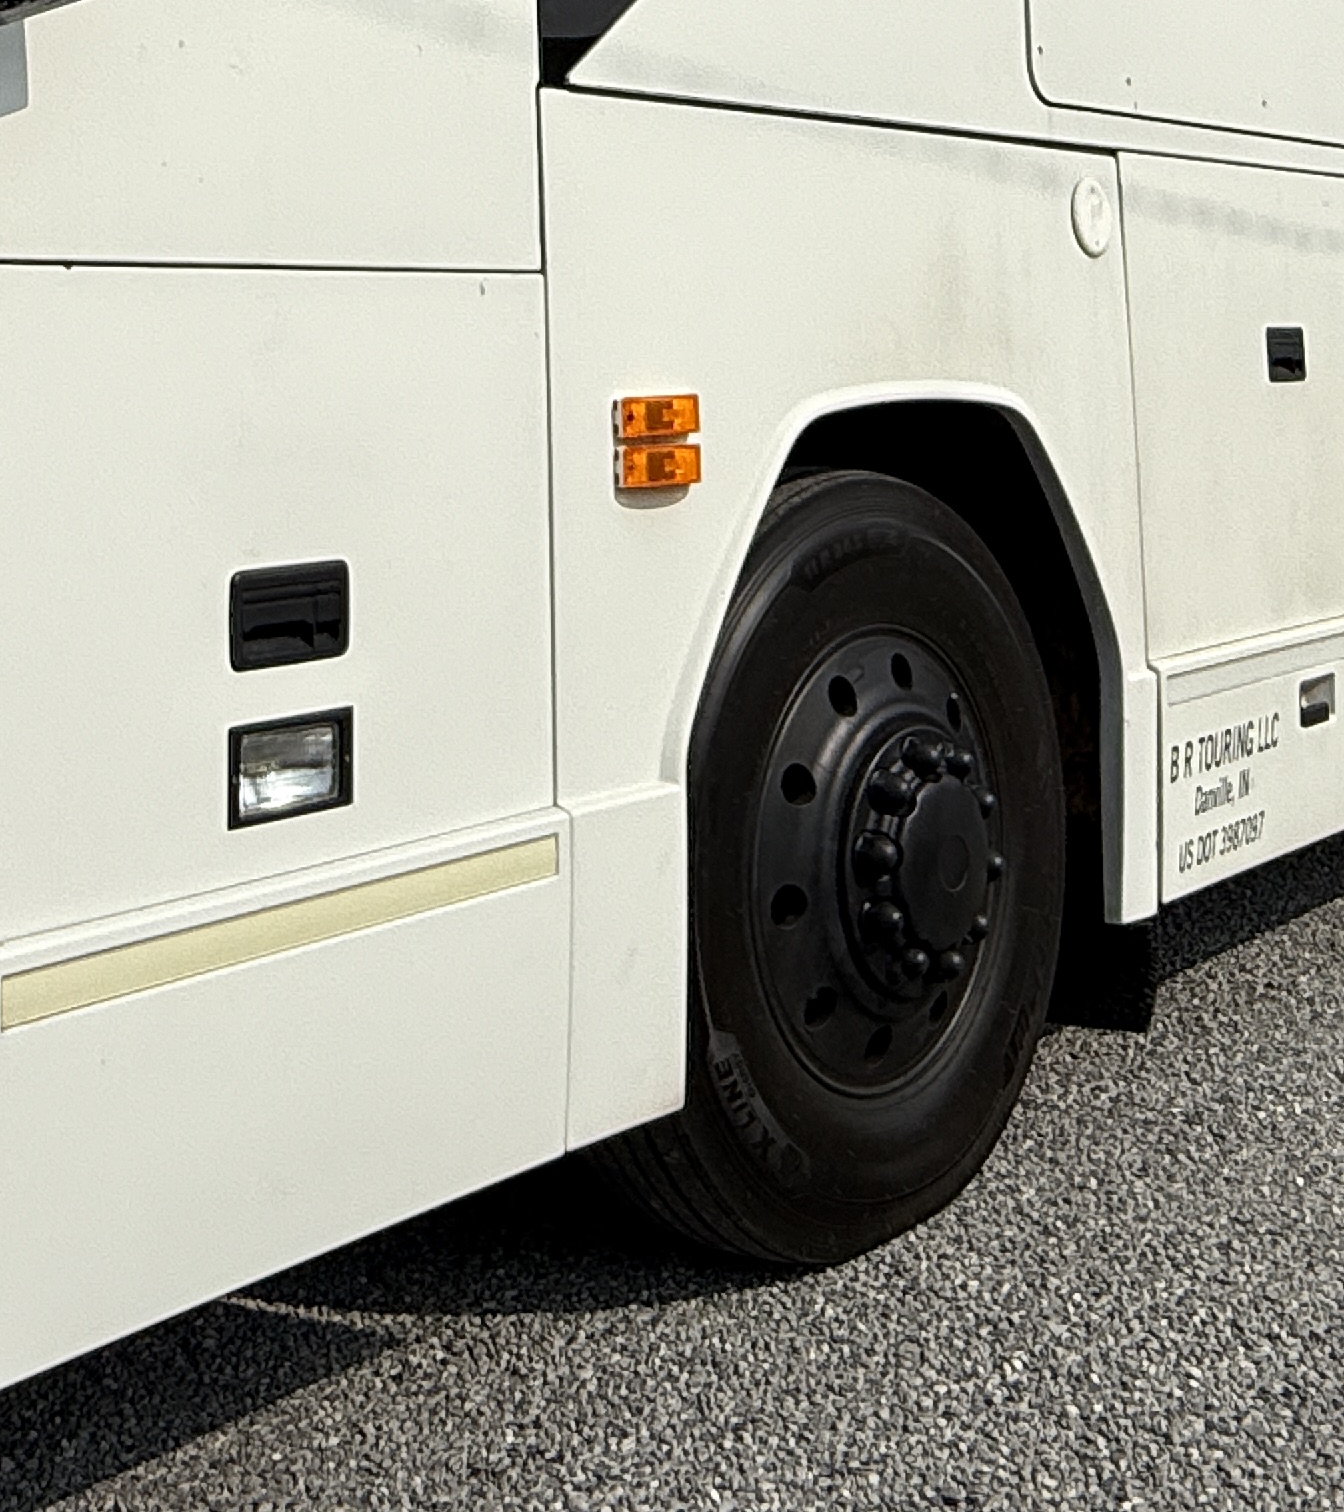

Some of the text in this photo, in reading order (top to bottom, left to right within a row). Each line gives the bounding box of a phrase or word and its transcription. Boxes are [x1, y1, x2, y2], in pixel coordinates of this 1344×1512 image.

[1170, 711, 1280, 784] B R TOURING LLC
[1238, 767, 1251, 799] IN
[1178, 838, 1194, 874] US
[1196, 828, 1219, 865] DOT
[714, 1058, 756, 1128] LINE
